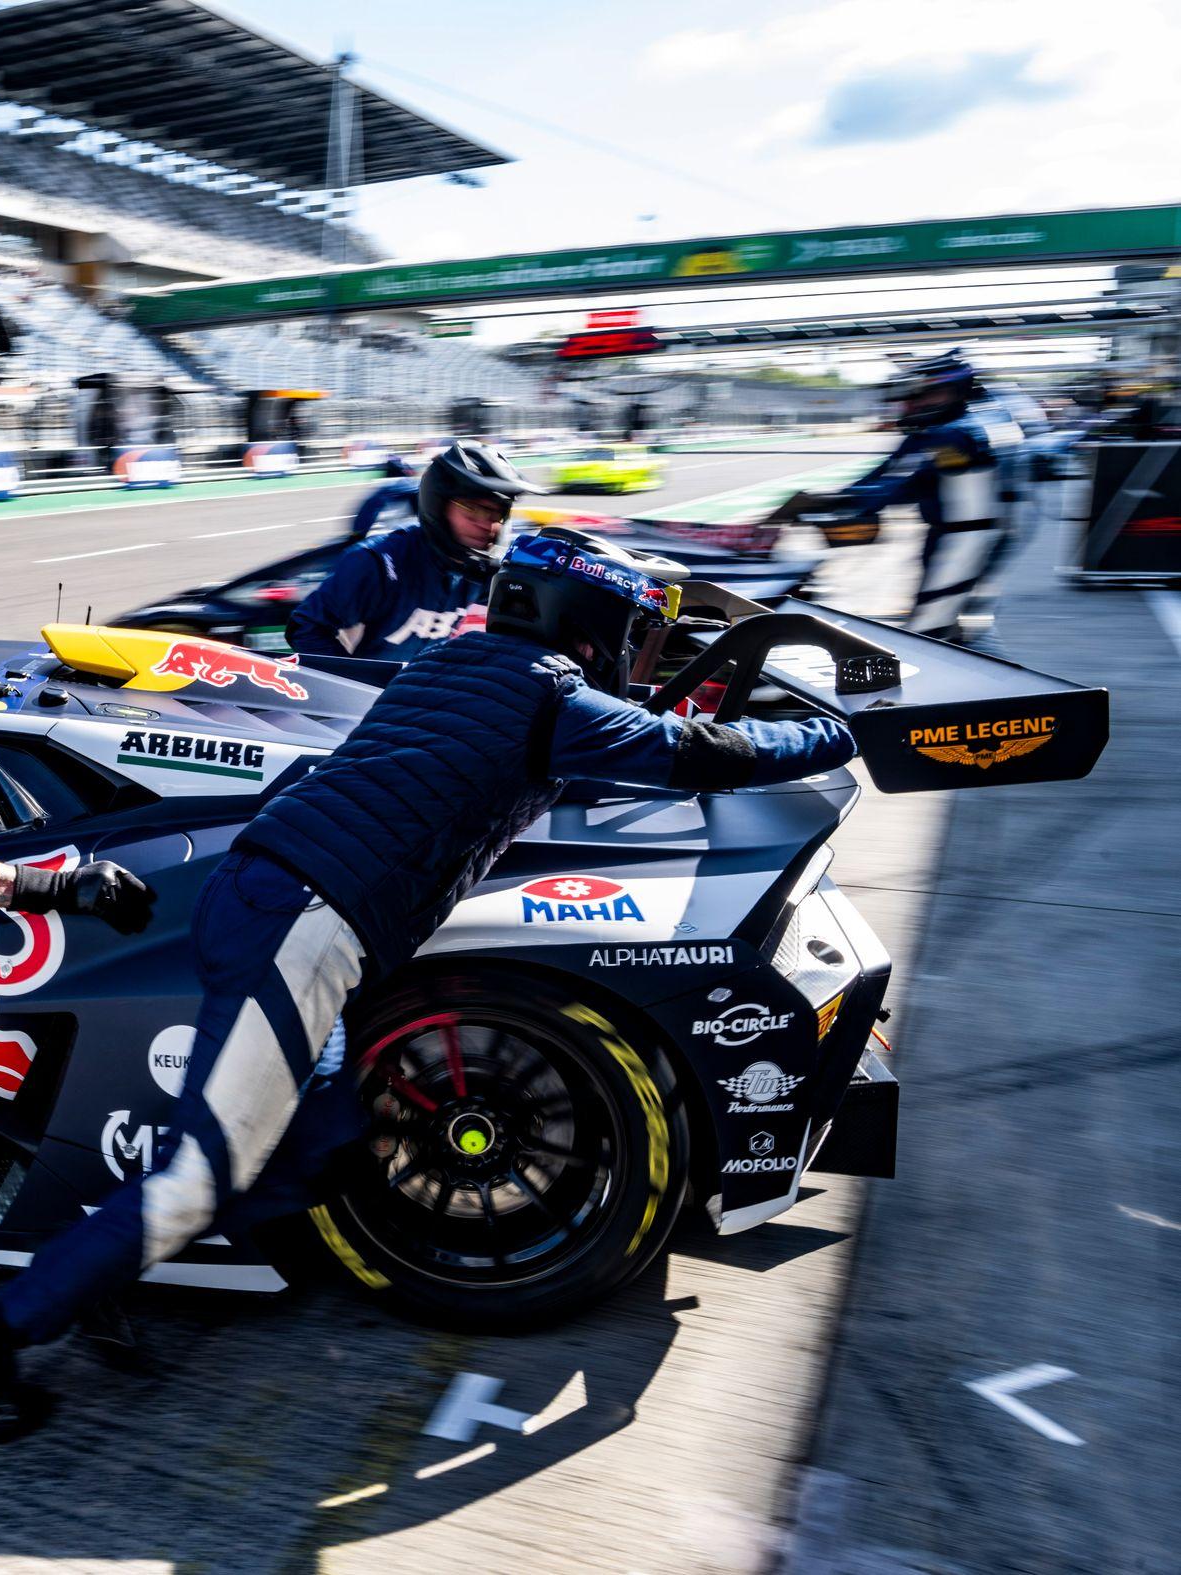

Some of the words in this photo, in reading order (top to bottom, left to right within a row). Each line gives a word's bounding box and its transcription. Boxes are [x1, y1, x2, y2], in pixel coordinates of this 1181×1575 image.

[571, 556, 605, 579] Bull
[603, 572, 638, 592] SPECT
[910, 725, 959, 746] PME
[965, 716, 1056, 740] LEGEND
[120, 731, 265, 768] ARBURG
[522, 893, 646, 923] MAHA
[588, 945, 734, 967] ALPHATAURI
[727, 1101, 795, 1114] Performance
